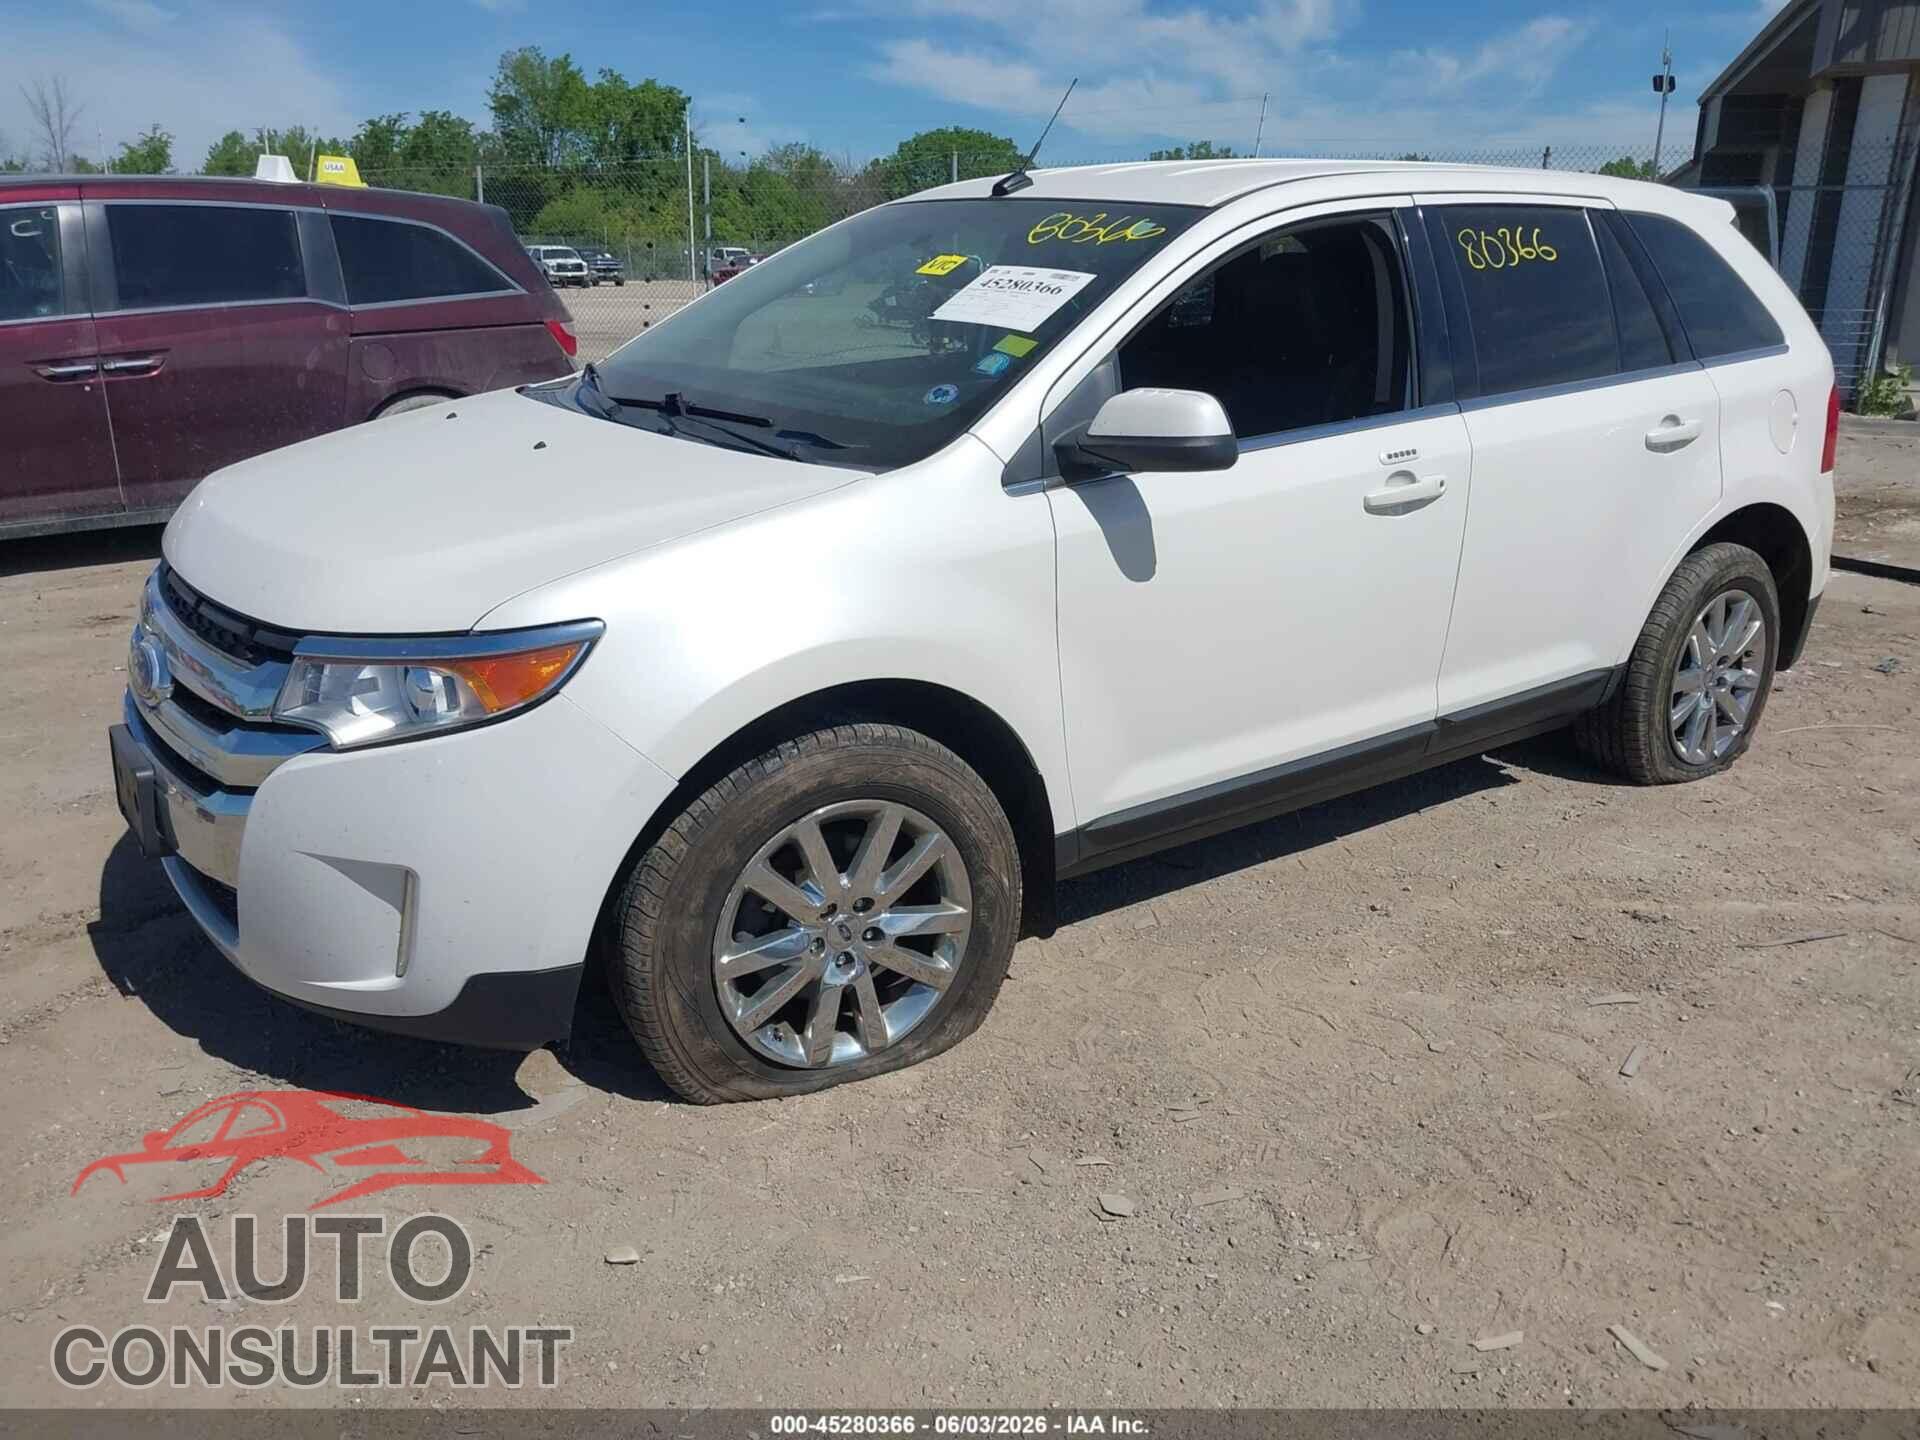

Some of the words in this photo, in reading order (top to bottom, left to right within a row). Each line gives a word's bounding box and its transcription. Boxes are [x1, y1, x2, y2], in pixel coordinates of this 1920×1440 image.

[325, 163, 344, 171] USAA
[1458, 226, 1558, 269] 80366
[980, 277, 1063, 295] 45280366
